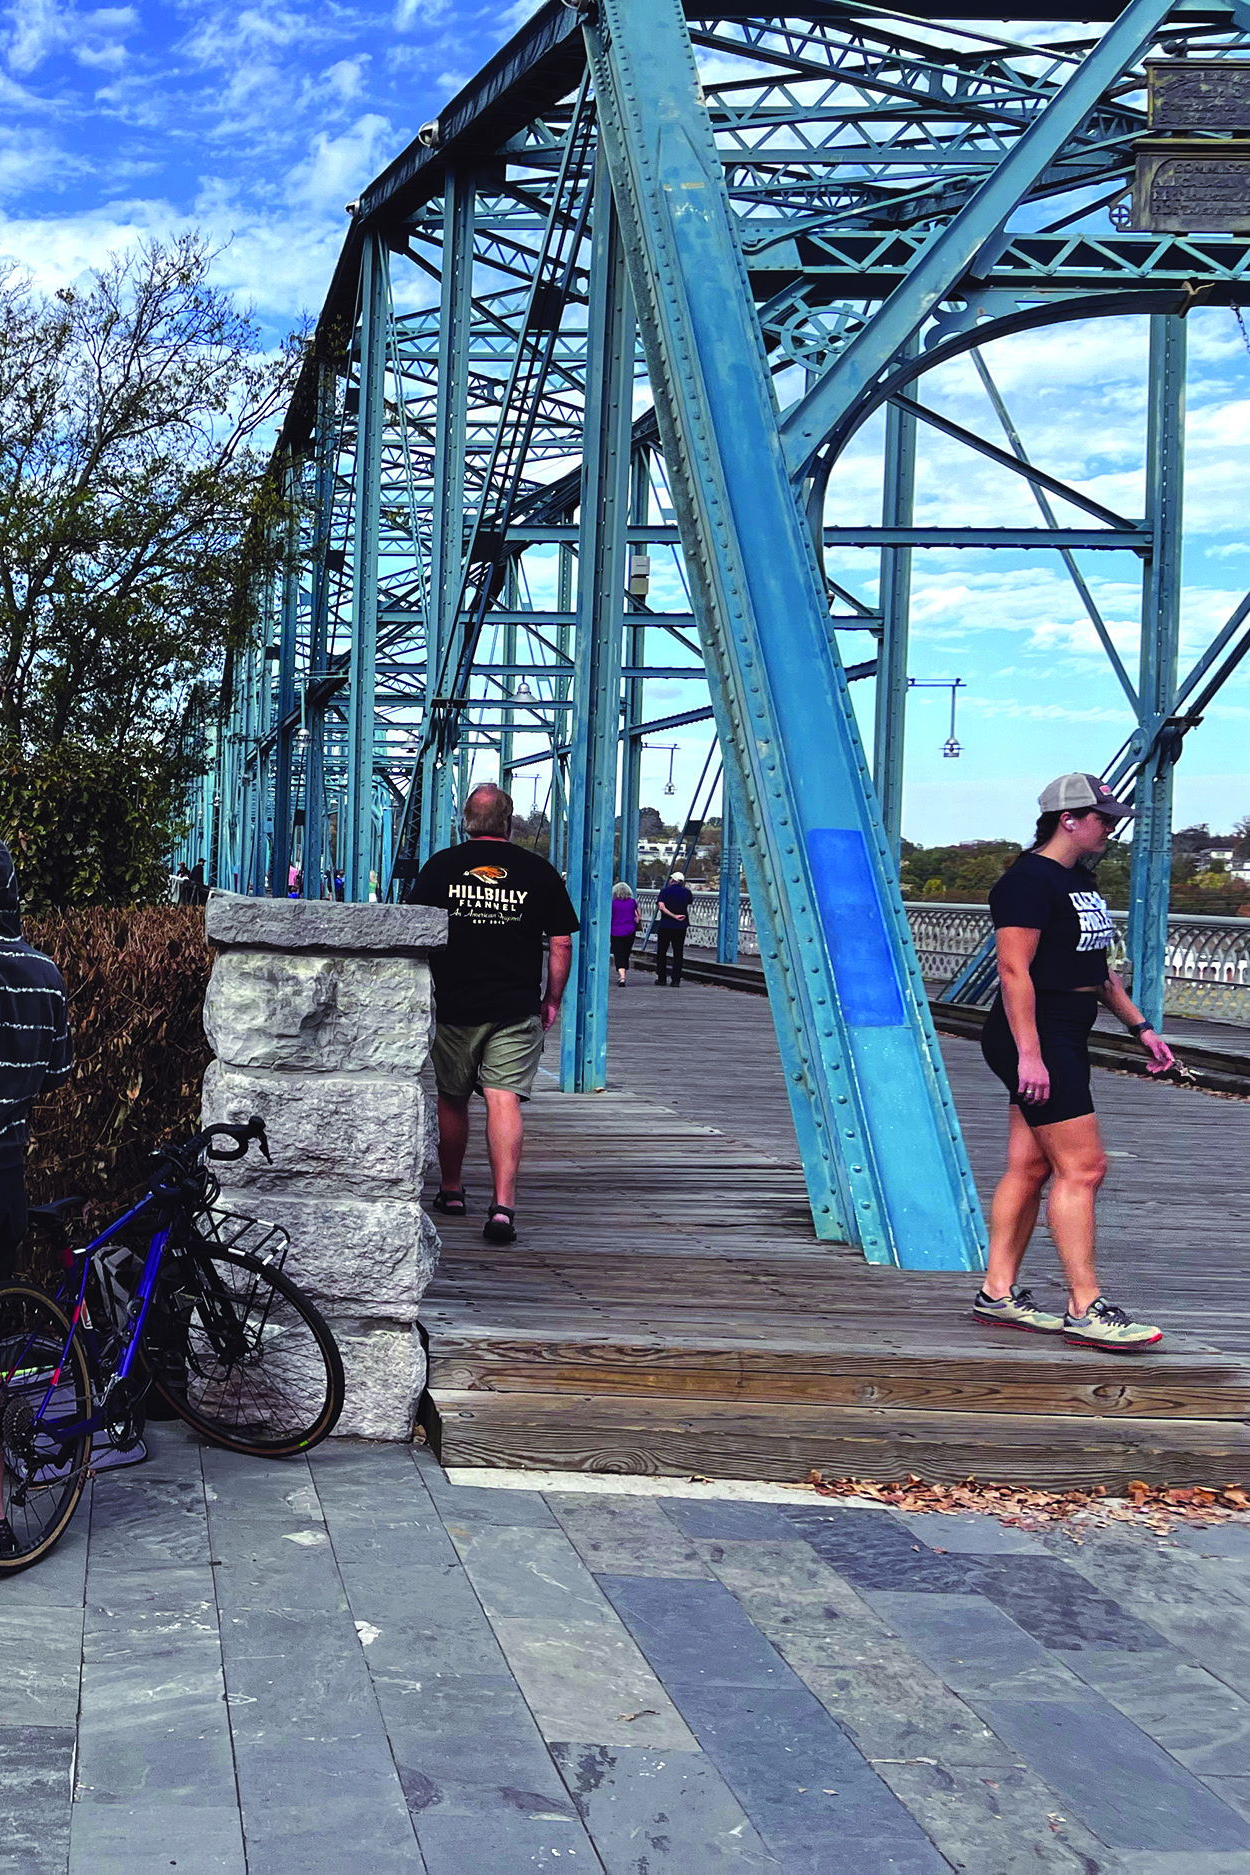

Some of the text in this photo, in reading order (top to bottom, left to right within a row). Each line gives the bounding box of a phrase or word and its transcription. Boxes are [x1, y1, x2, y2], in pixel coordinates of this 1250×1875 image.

[448, 884, 528, 904] HILLBILLY
[459, 899, 517, 911] FLANNEL
[463, 908, 497, 919] American
